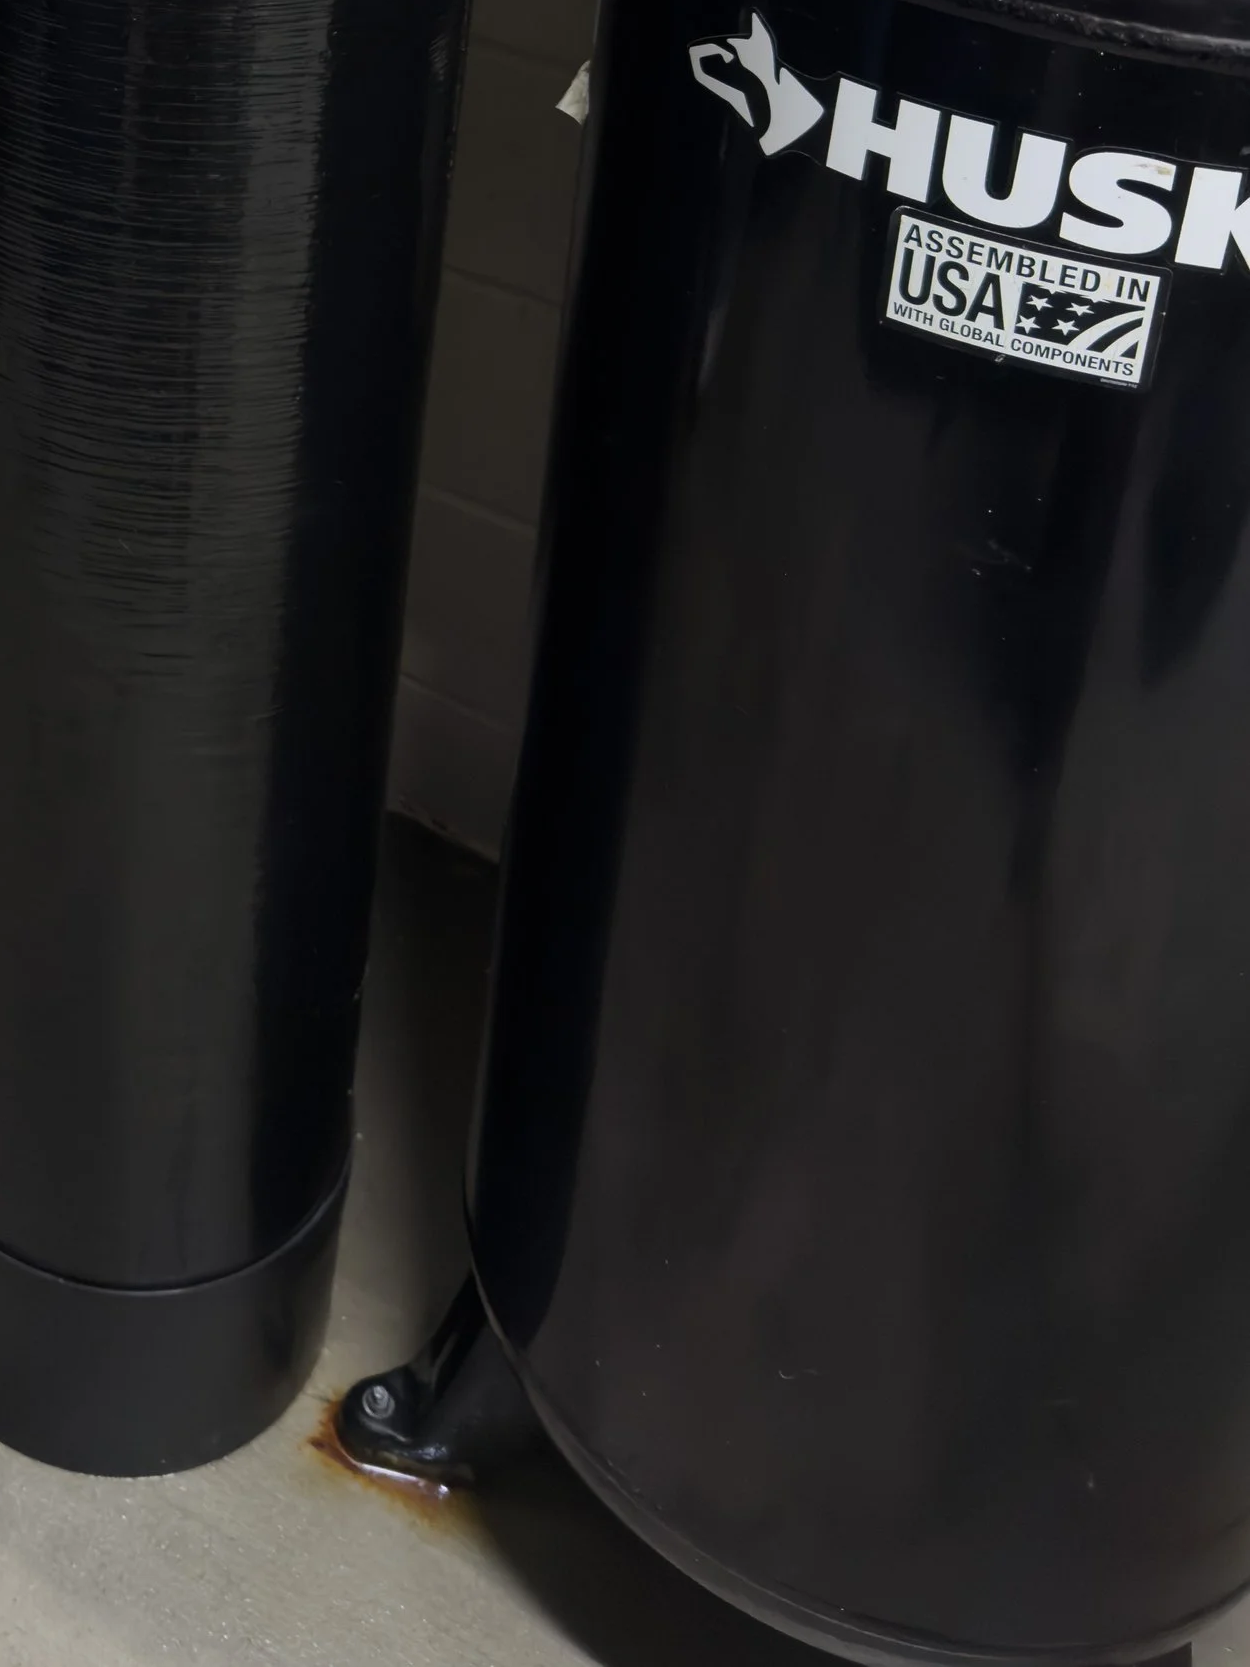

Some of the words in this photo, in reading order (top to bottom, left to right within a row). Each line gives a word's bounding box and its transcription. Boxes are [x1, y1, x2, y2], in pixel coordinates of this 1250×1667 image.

[899, 247, 1005, 331] USA
[903, 224, 1101, 293] ASSEMBLED
[1115, 276, 1151, 303] IN
[893, 302, 934, 327] WITH
[939, 318, 1005, 348] GLOBAL
[1011, 338, 1134, 376] COMPONENTS
